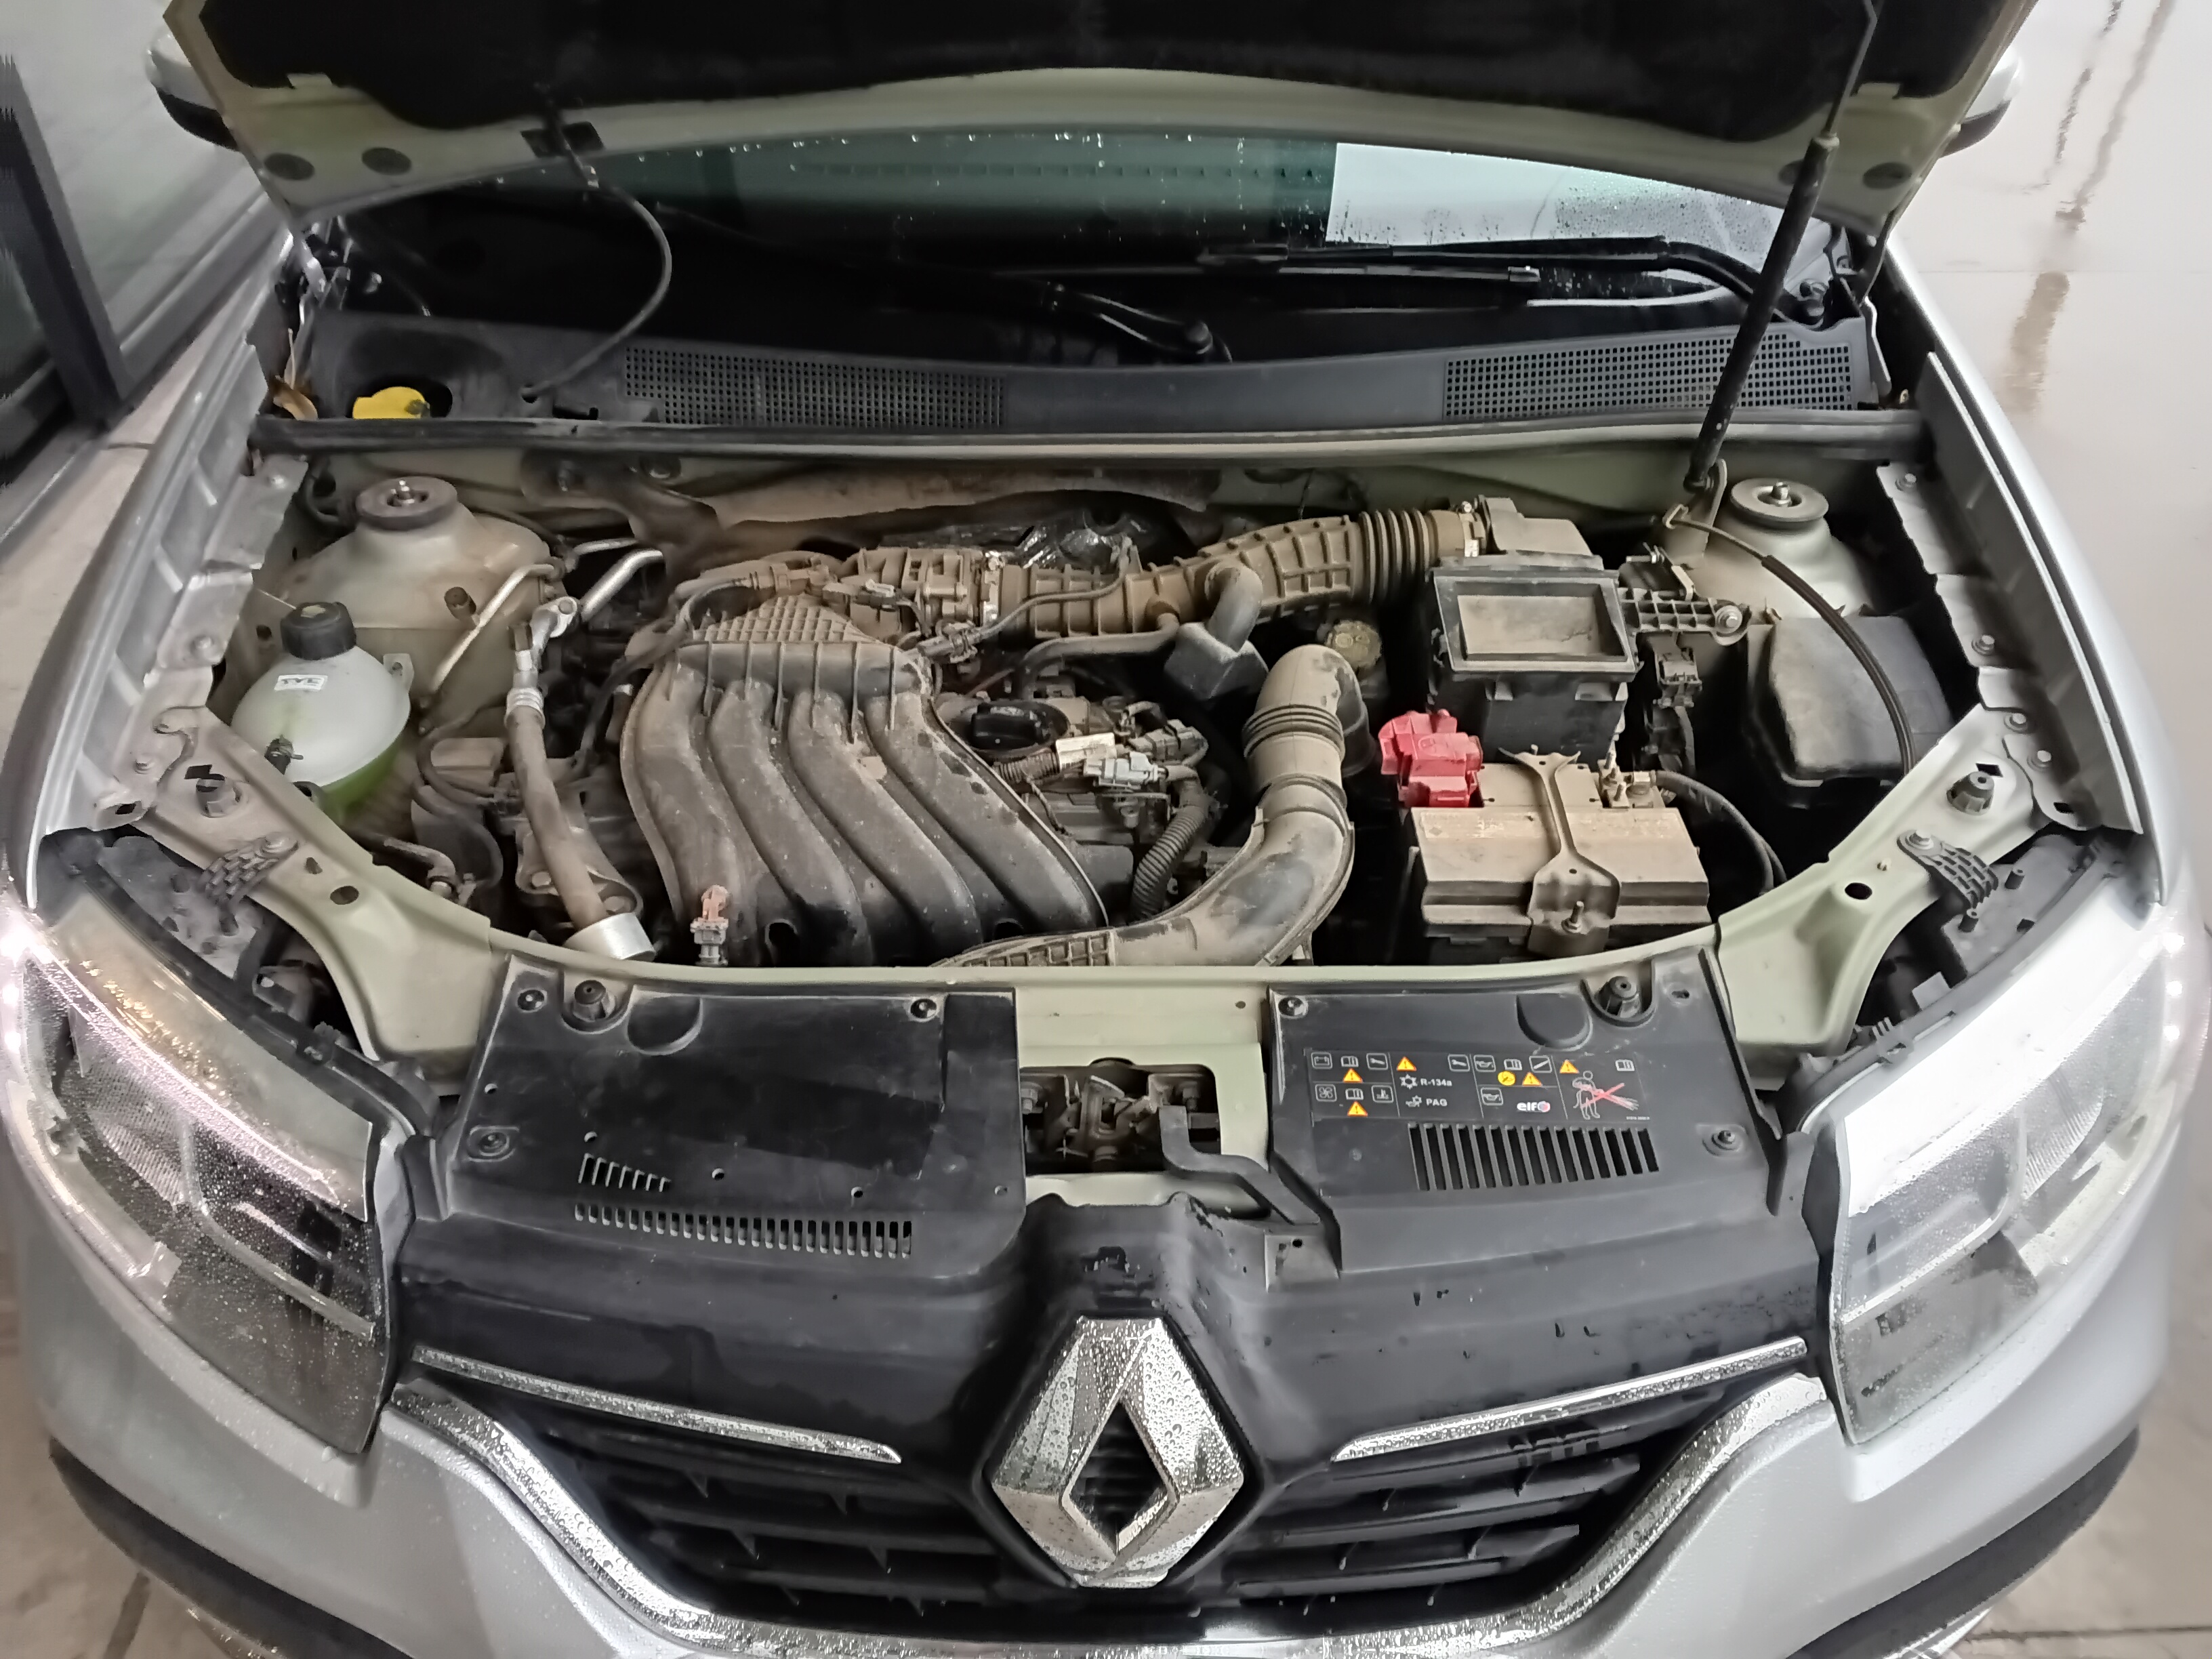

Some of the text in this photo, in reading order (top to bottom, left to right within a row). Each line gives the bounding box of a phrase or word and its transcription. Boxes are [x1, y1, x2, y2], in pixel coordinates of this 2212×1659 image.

[1420, 1078, 1452, 1086] R-134a
[1426, 1098, 1448, 1107] PAG
[1517, 1101, 1539, 1112] elf
